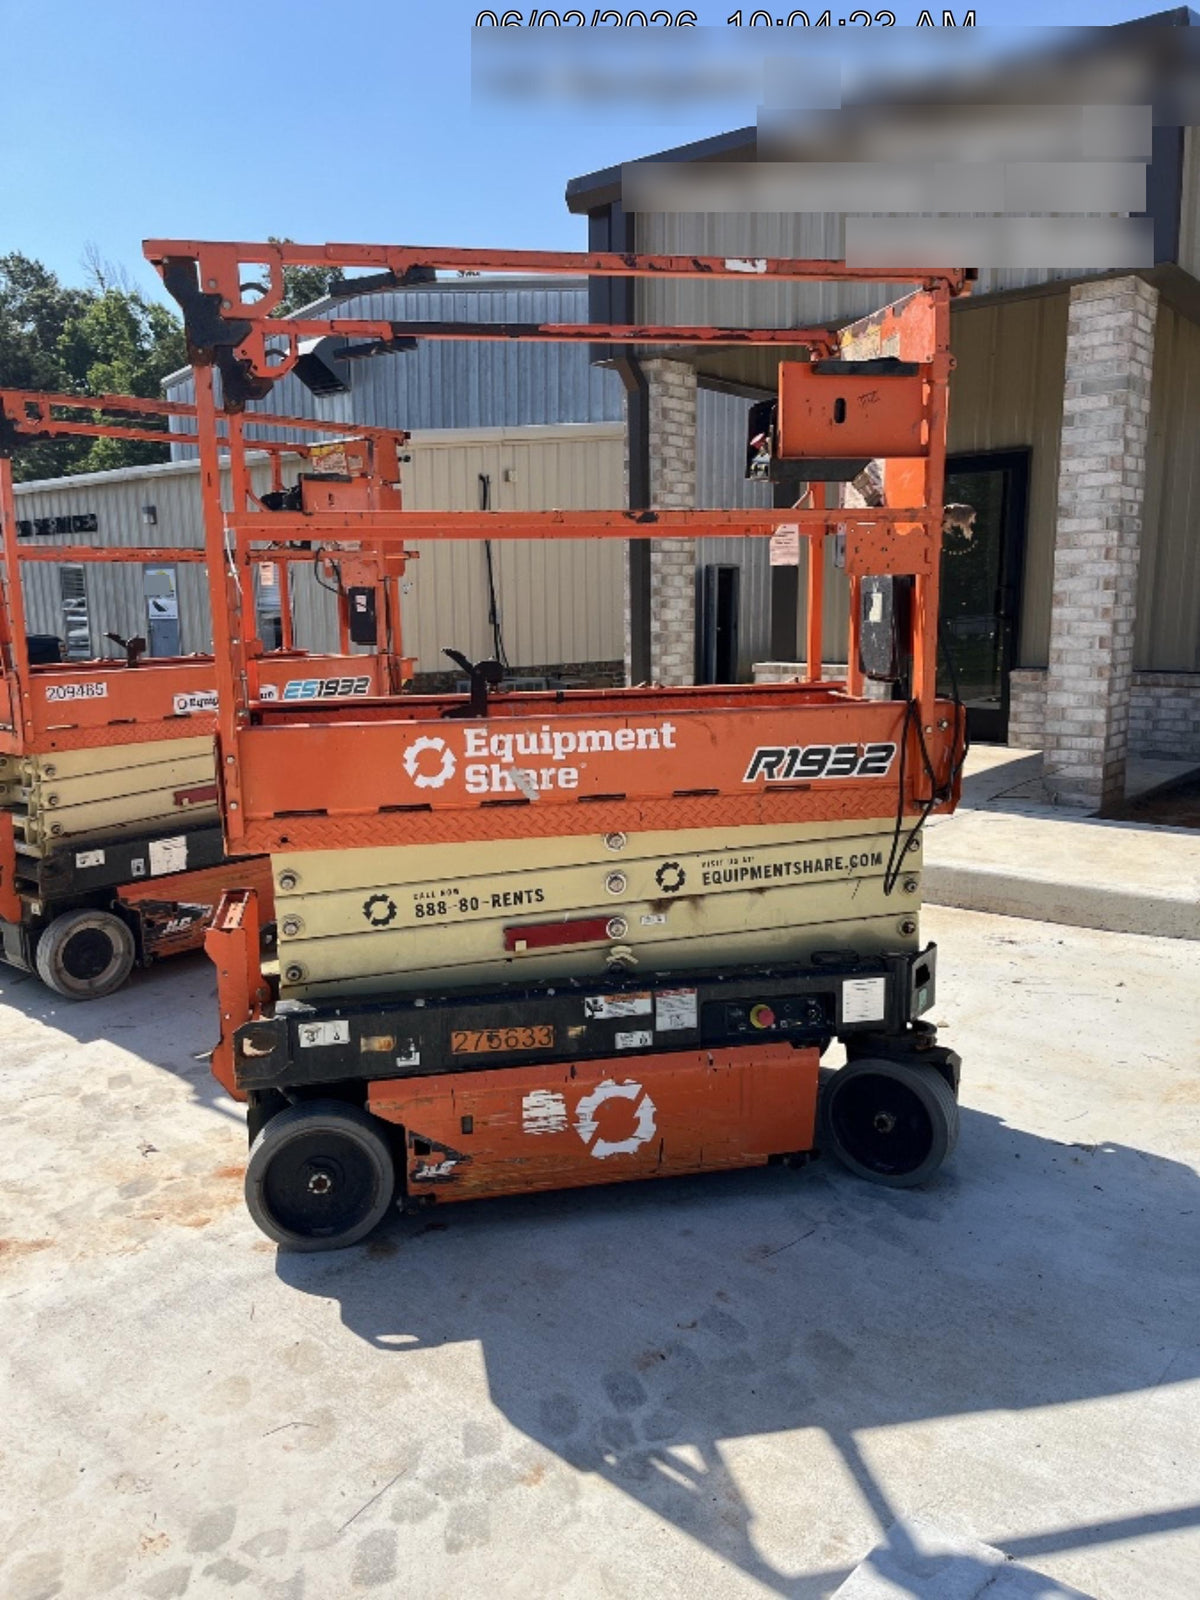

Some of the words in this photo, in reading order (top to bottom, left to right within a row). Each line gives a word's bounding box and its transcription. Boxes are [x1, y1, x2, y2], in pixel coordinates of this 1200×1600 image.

[284, 677, 370, 699] ES1932
[463, 722, 677, 764] Equipment
[743, 743, 897, 782] R1932
[464, 763, 579, 795] Share
[702, 852, 883, 886] EQUIPMENTSHARE.COM
[415, 888, 545, 918] 888-80-RENTS
[454, 1027, 552, 1052] 275633
